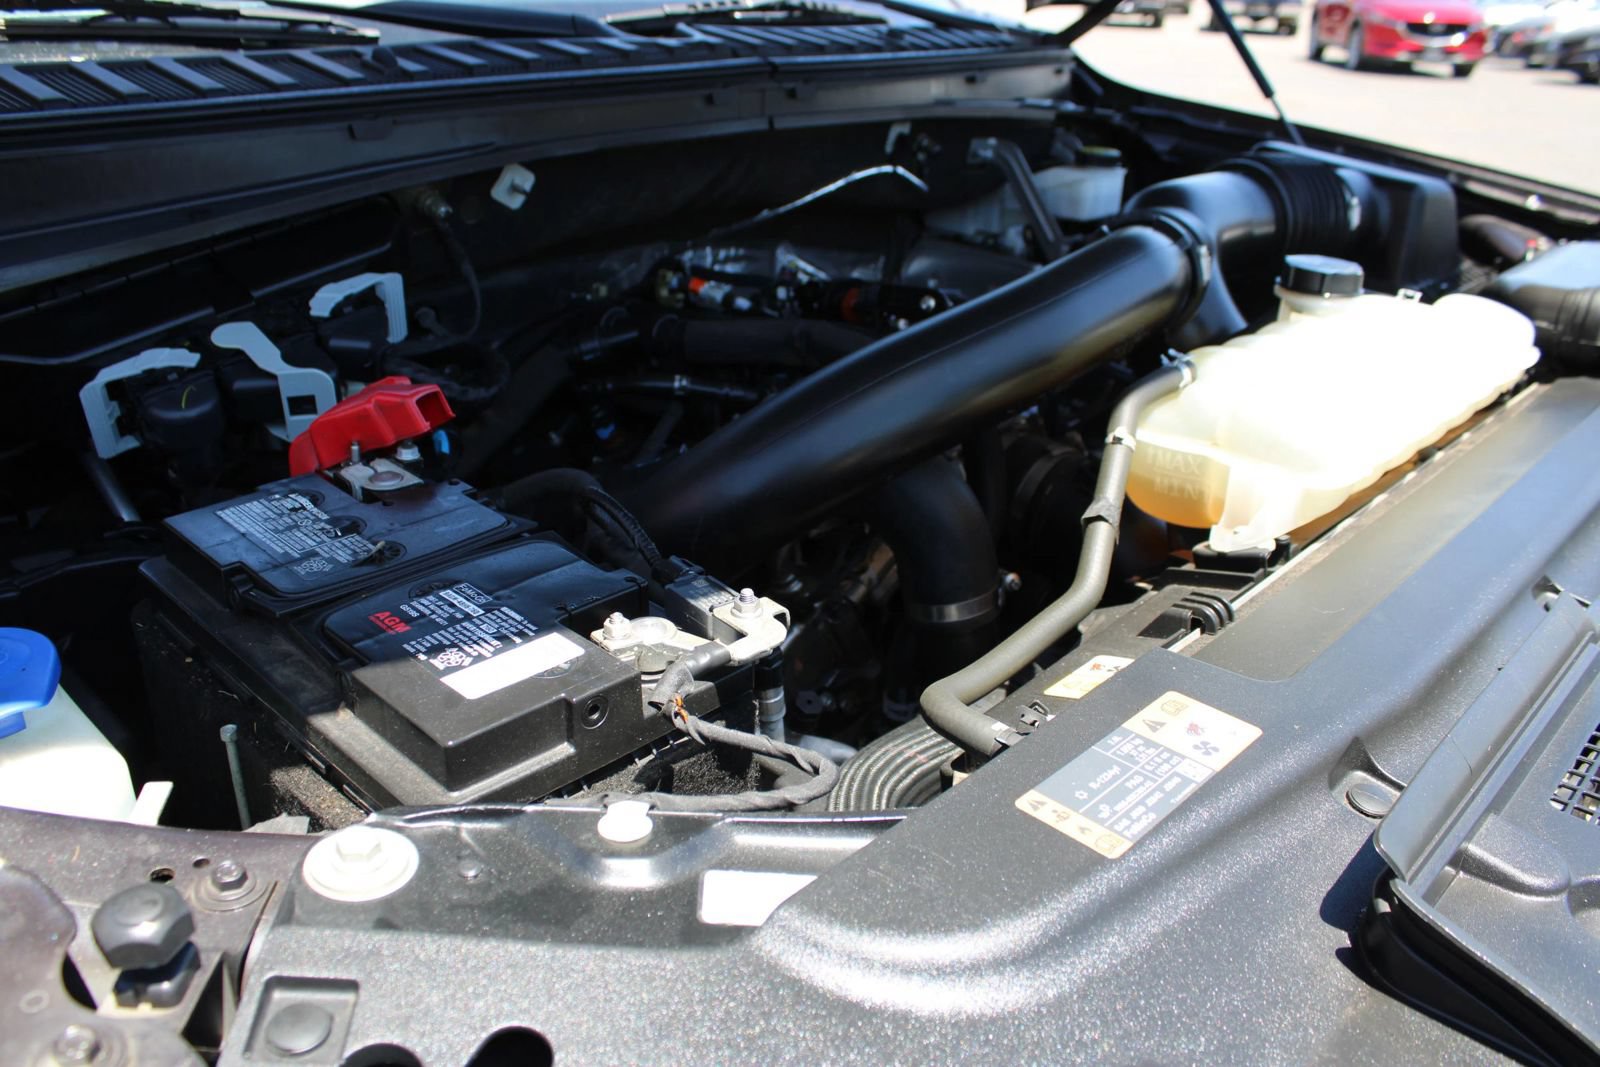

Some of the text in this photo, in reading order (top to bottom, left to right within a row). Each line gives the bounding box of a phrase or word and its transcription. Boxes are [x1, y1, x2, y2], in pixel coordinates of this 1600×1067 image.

[1156, 449, 1202, 474] MAX
[1154, 476, 1200, 500] MIN
[458, 584, 488, 603] FoMoCo
[374, 611, 412, 632] AGM
